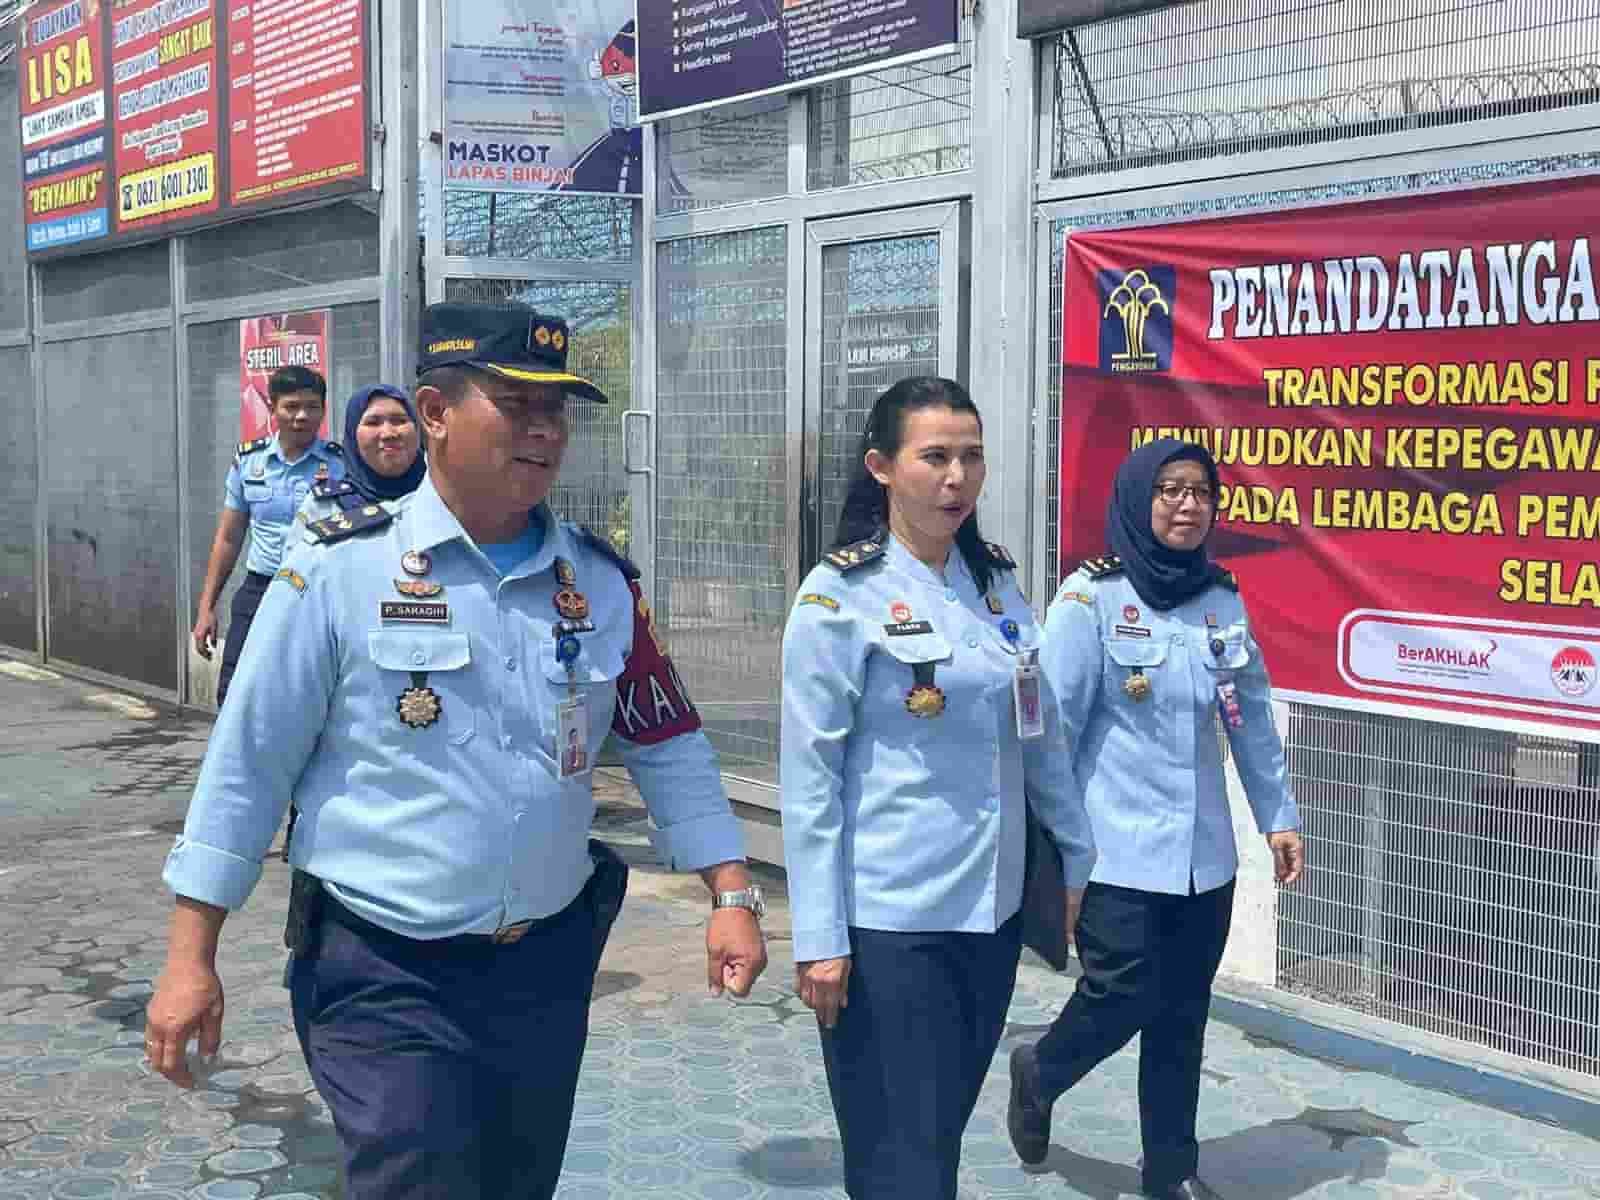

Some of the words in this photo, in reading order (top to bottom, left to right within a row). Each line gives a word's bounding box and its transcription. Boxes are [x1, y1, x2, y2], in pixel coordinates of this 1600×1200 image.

[27, 35, 93, 105] LISA
[448, 165, 507, 181] LAPAS
[511, 166, 575, 185] BINJAI
[449, 141, 551, 164] MASKOT
[1208, 236, 1600, 340] PENANDATANGA
[247, 345, 284, 369] STERIL
[287, 342, 320, 364] AREA
[1263, 359, 1570, 407] TRANSFORMASI
[1312, 487, 1504, 536] LEMBAGA
[1498, 558, 1600, 609] SELA
[1397, 642, 1491, 669] BerAKHLAK
